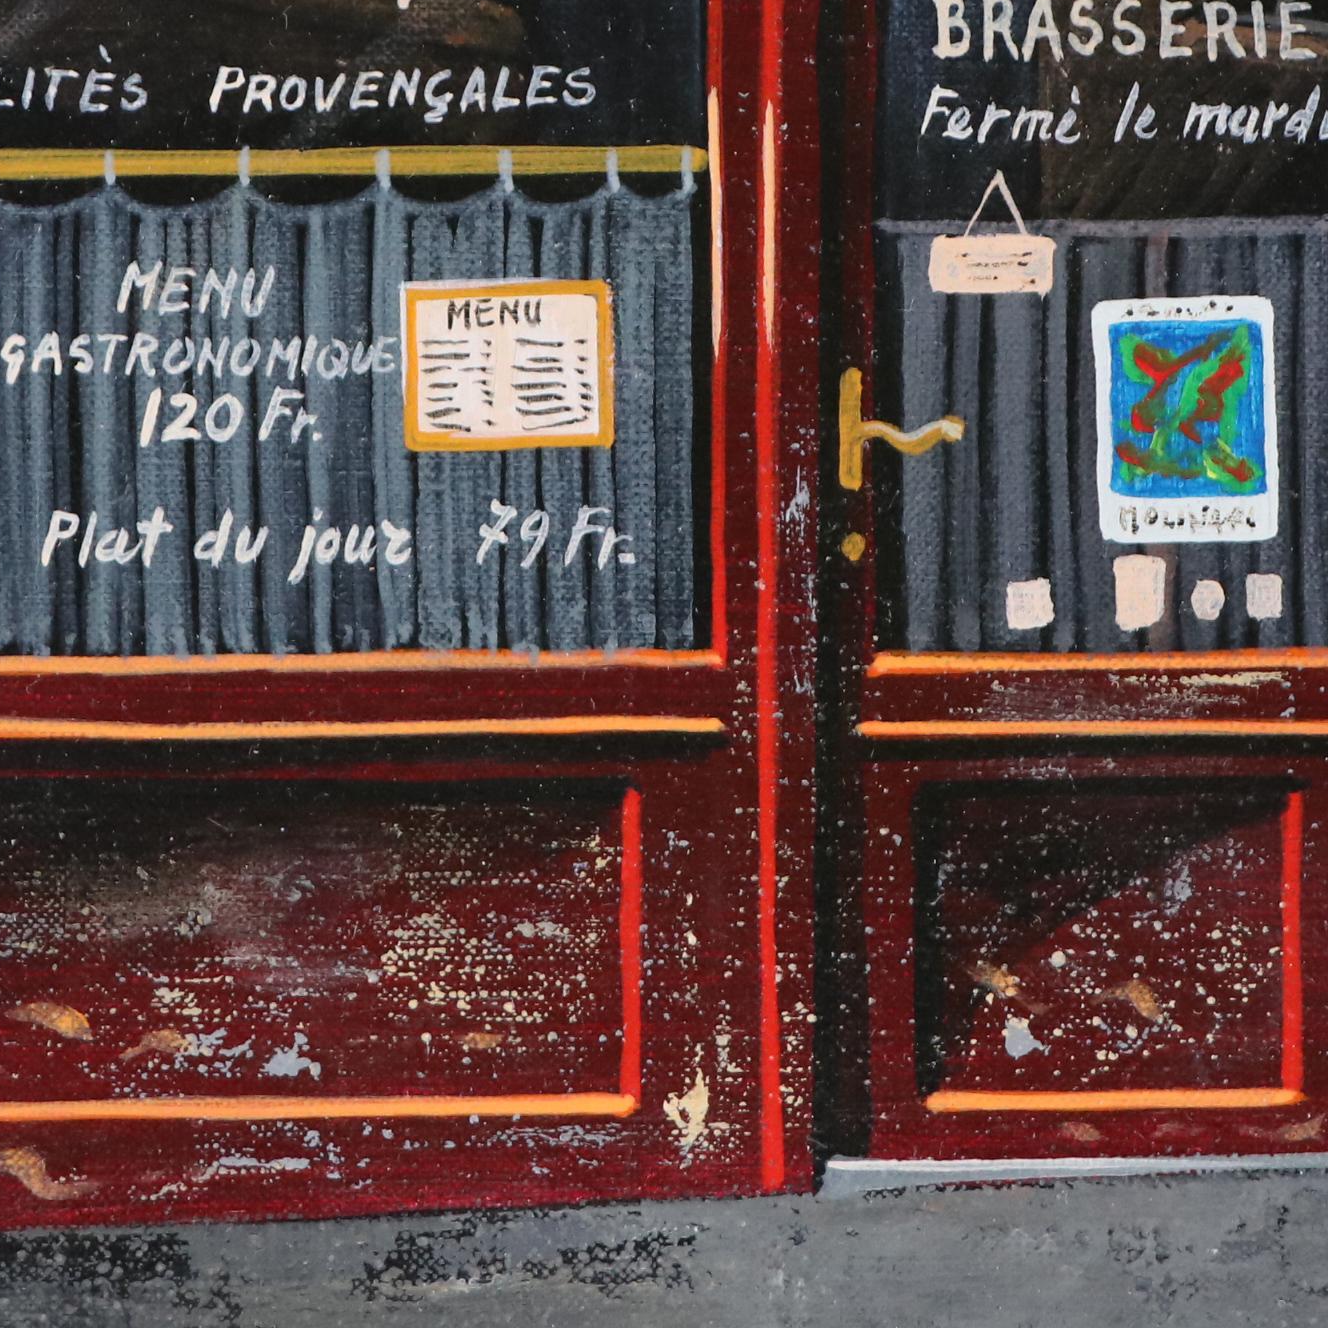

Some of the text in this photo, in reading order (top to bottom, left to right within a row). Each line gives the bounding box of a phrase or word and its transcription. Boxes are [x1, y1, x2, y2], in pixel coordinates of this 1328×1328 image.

[210, 65, 597, 123] PROVENÇALES
[1114, 82, 1158, 142] le
[117, 260, 275, 320] MENU
[447, 298, 542, 330] MENU
[0, 333, 398, 384] GASTRONOMIQUE
[139, 386, 323, 447] 120 Fr.
[41, 507, 174, 568] Plat
[194, 508, 269, 568] du
[287, 506, 413, 585] jour
[477, 498, 550, 569] 79
